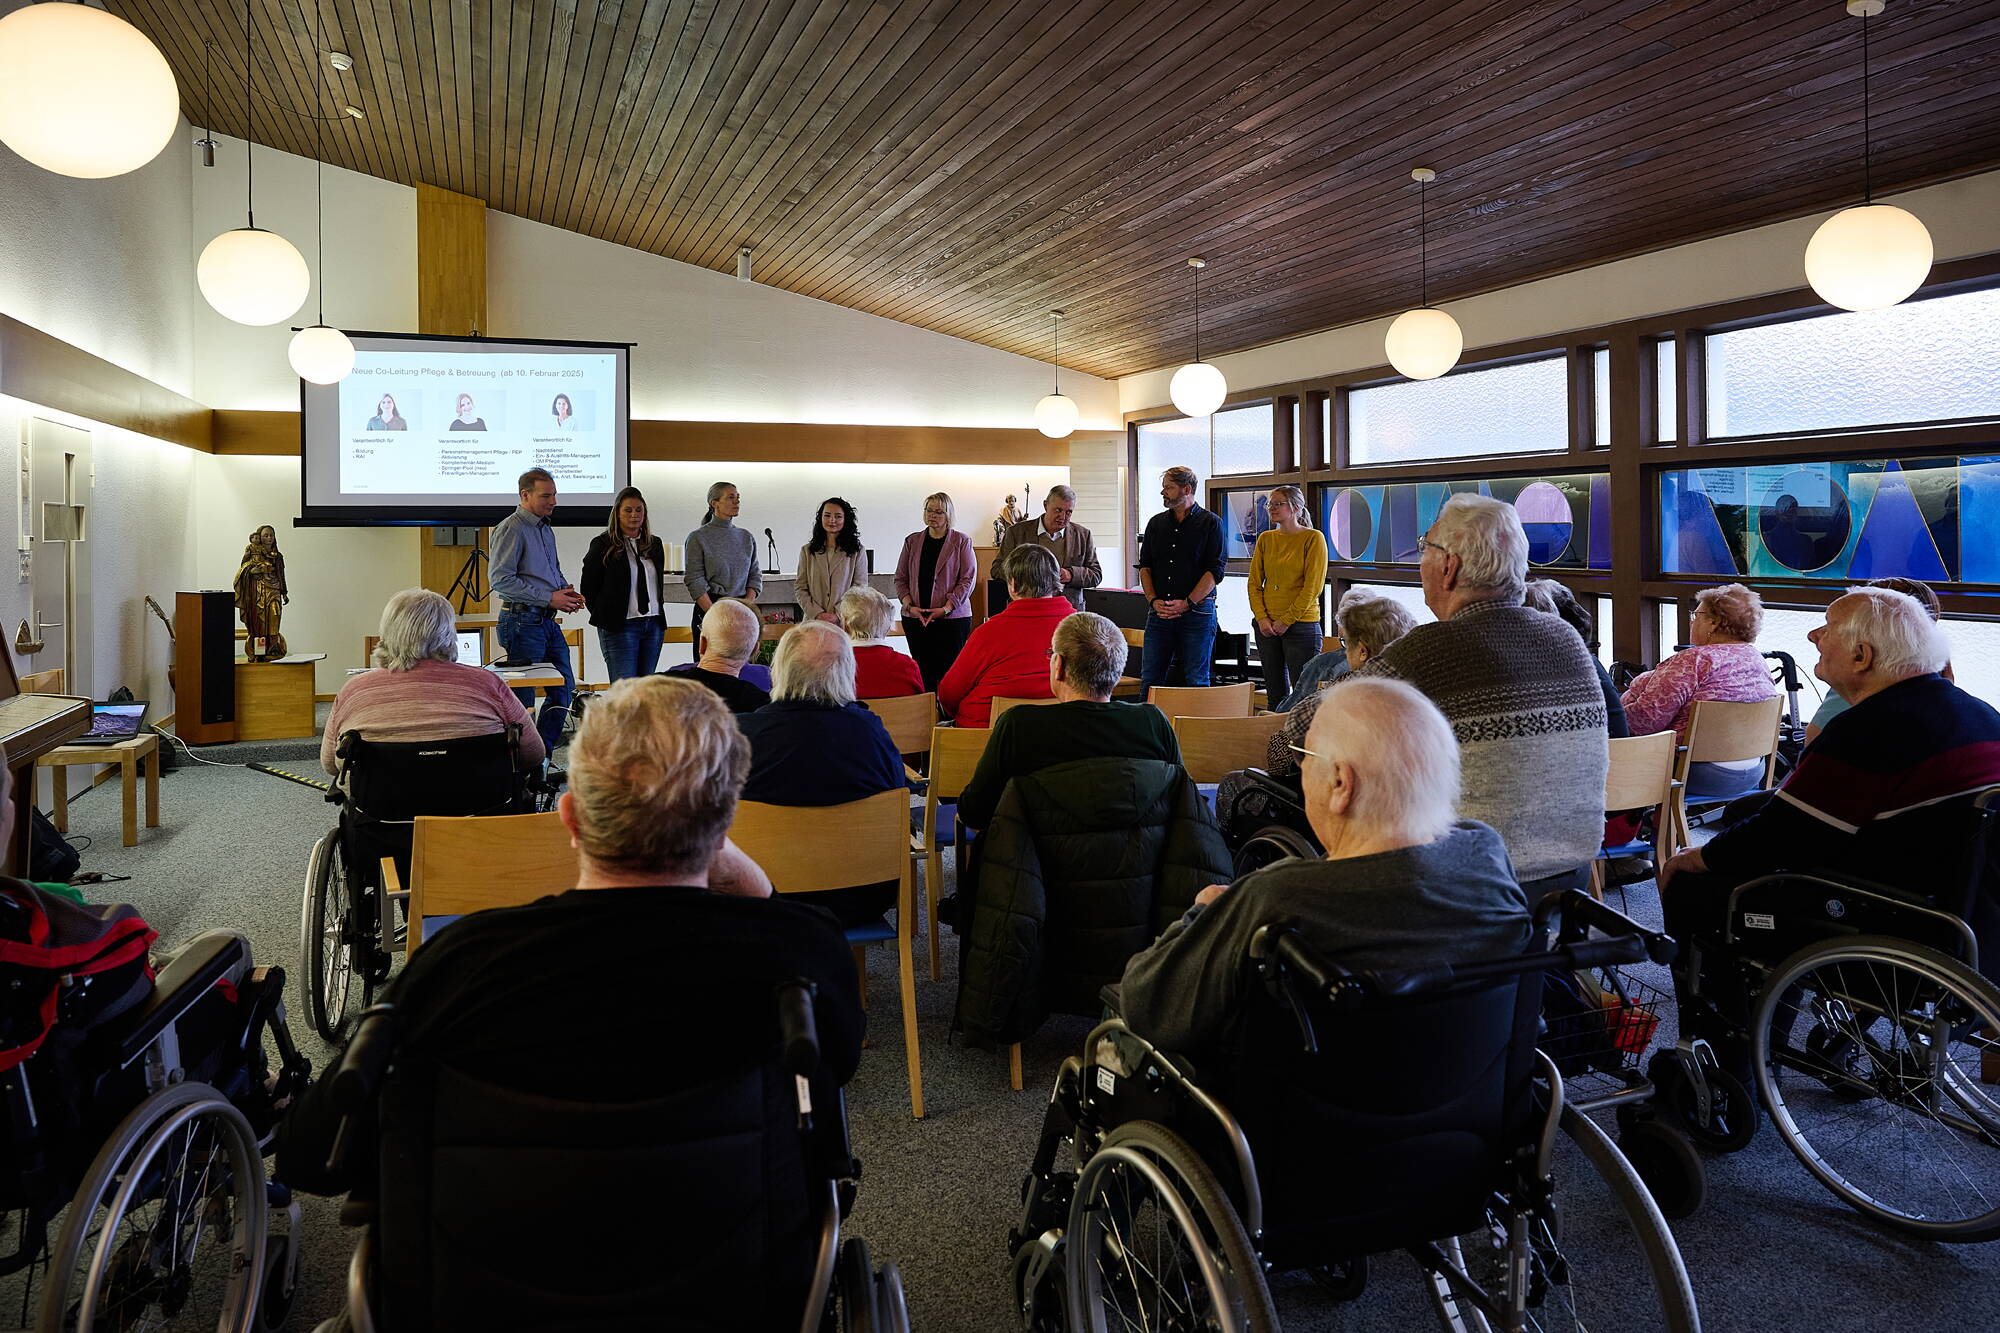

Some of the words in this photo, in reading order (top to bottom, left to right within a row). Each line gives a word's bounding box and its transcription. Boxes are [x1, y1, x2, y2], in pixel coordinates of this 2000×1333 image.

[352, 367, 373, 375] Neue
[375, 367, 419, 377] Co-Leitung
[421, 367, 446, 377] Pflege
[448, 368, 454, 376] &
[456, 369, 496, 378] Betreuung
[500, 369, 513, 378] (ab
[516, 369, 527, 377] 10.
[529, 369, 560, 377] Februar
[561, 369, 584, 378] 2025)
